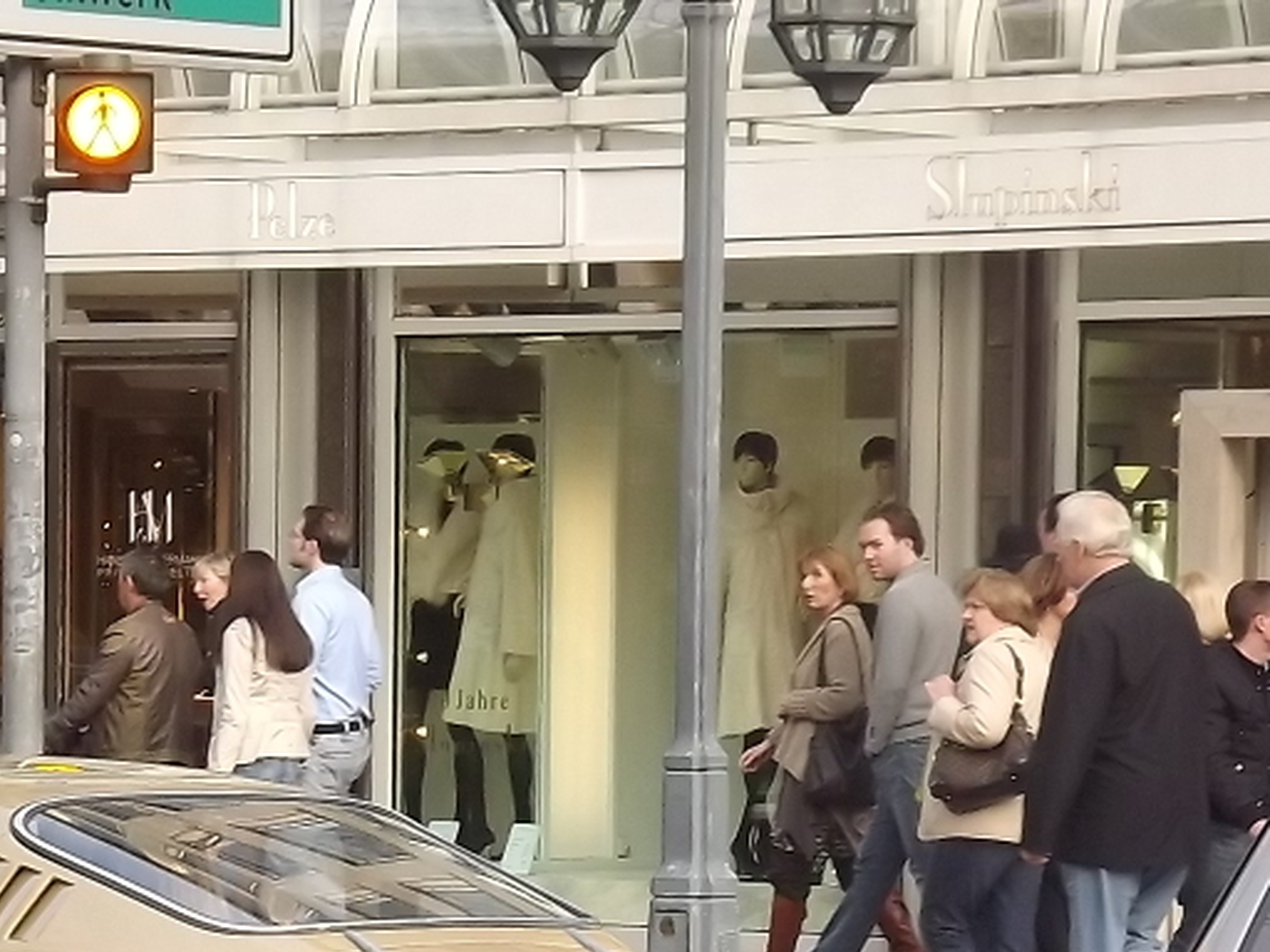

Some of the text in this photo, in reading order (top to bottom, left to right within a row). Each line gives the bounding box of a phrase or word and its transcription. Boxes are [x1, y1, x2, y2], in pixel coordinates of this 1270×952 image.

[248, 181, 336, 239] Pelze
[925, 150, 1121, 227] Slupinski
[456, 688, 509, 710] Jahre
